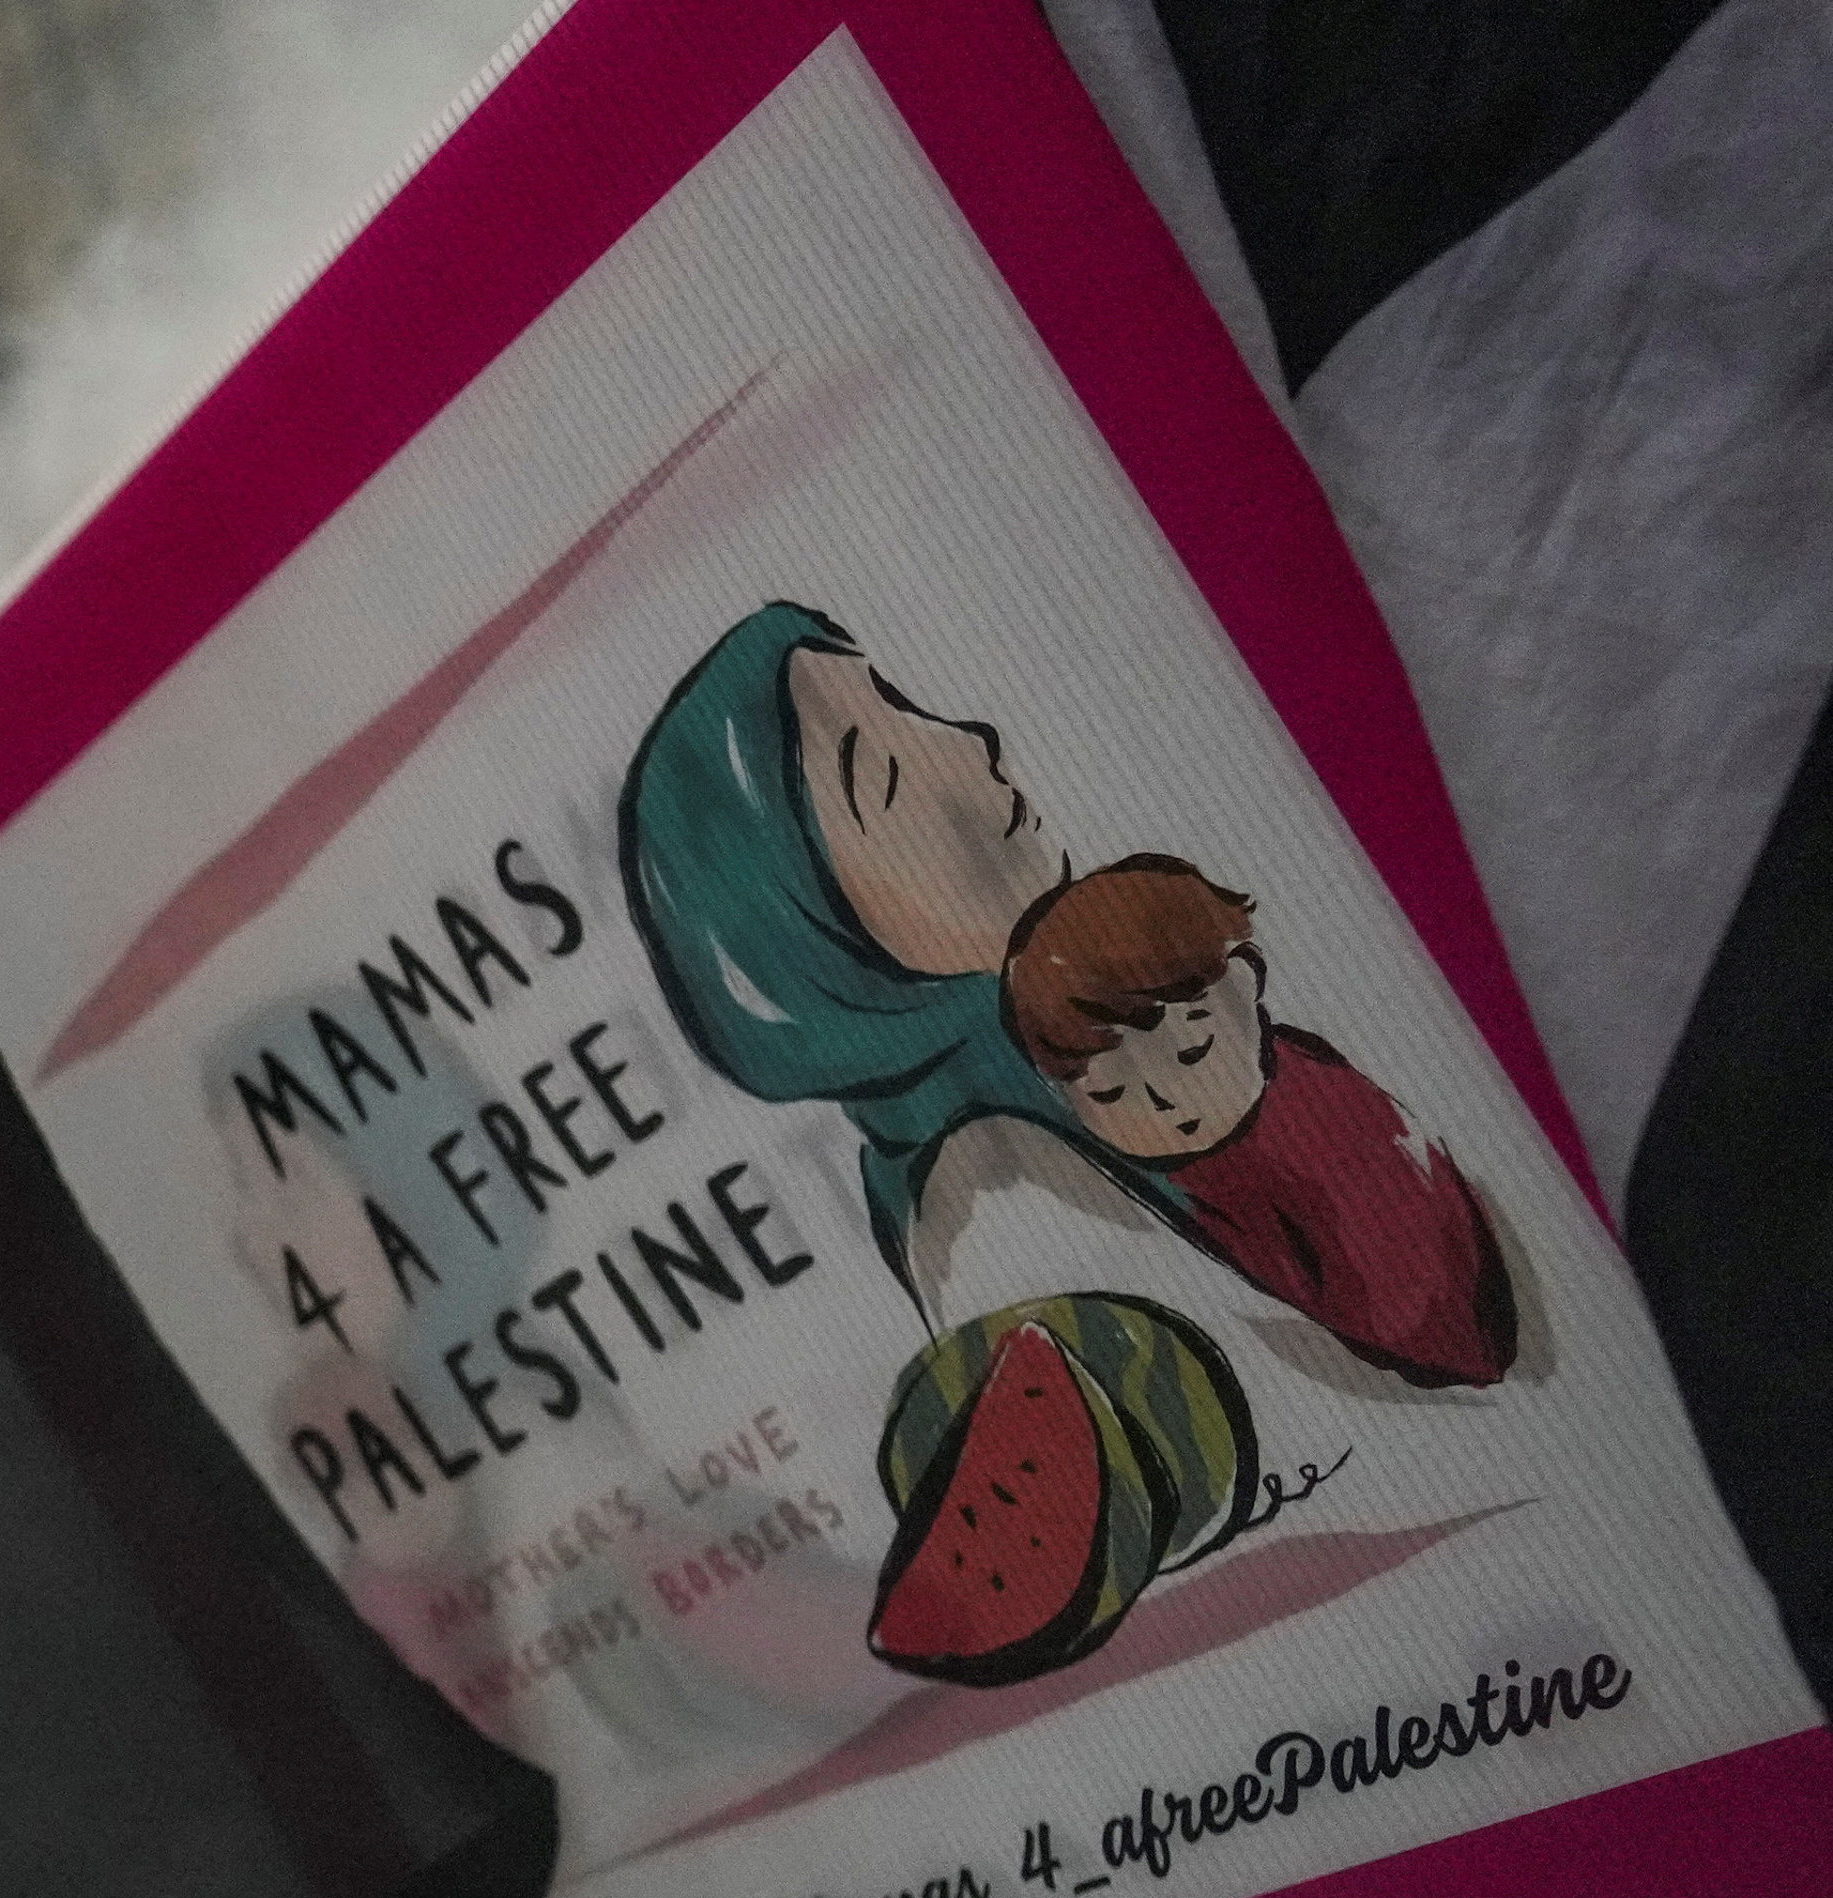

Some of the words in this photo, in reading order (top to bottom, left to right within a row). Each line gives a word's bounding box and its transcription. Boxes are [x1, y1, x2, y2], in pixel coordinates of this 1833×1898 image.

[233, 839, 583, 1178] MAMAS
[282, 1243, 354, 1355] 4
[362, 1196, 442, 1307] A
[427, 1020, 665, 1249] FREE
[289, 1160, 815, 1544] PALESTINE
[652, 1486, 845, 1616] BORDERS
[665, 1406, 800, 1508] LOVE
